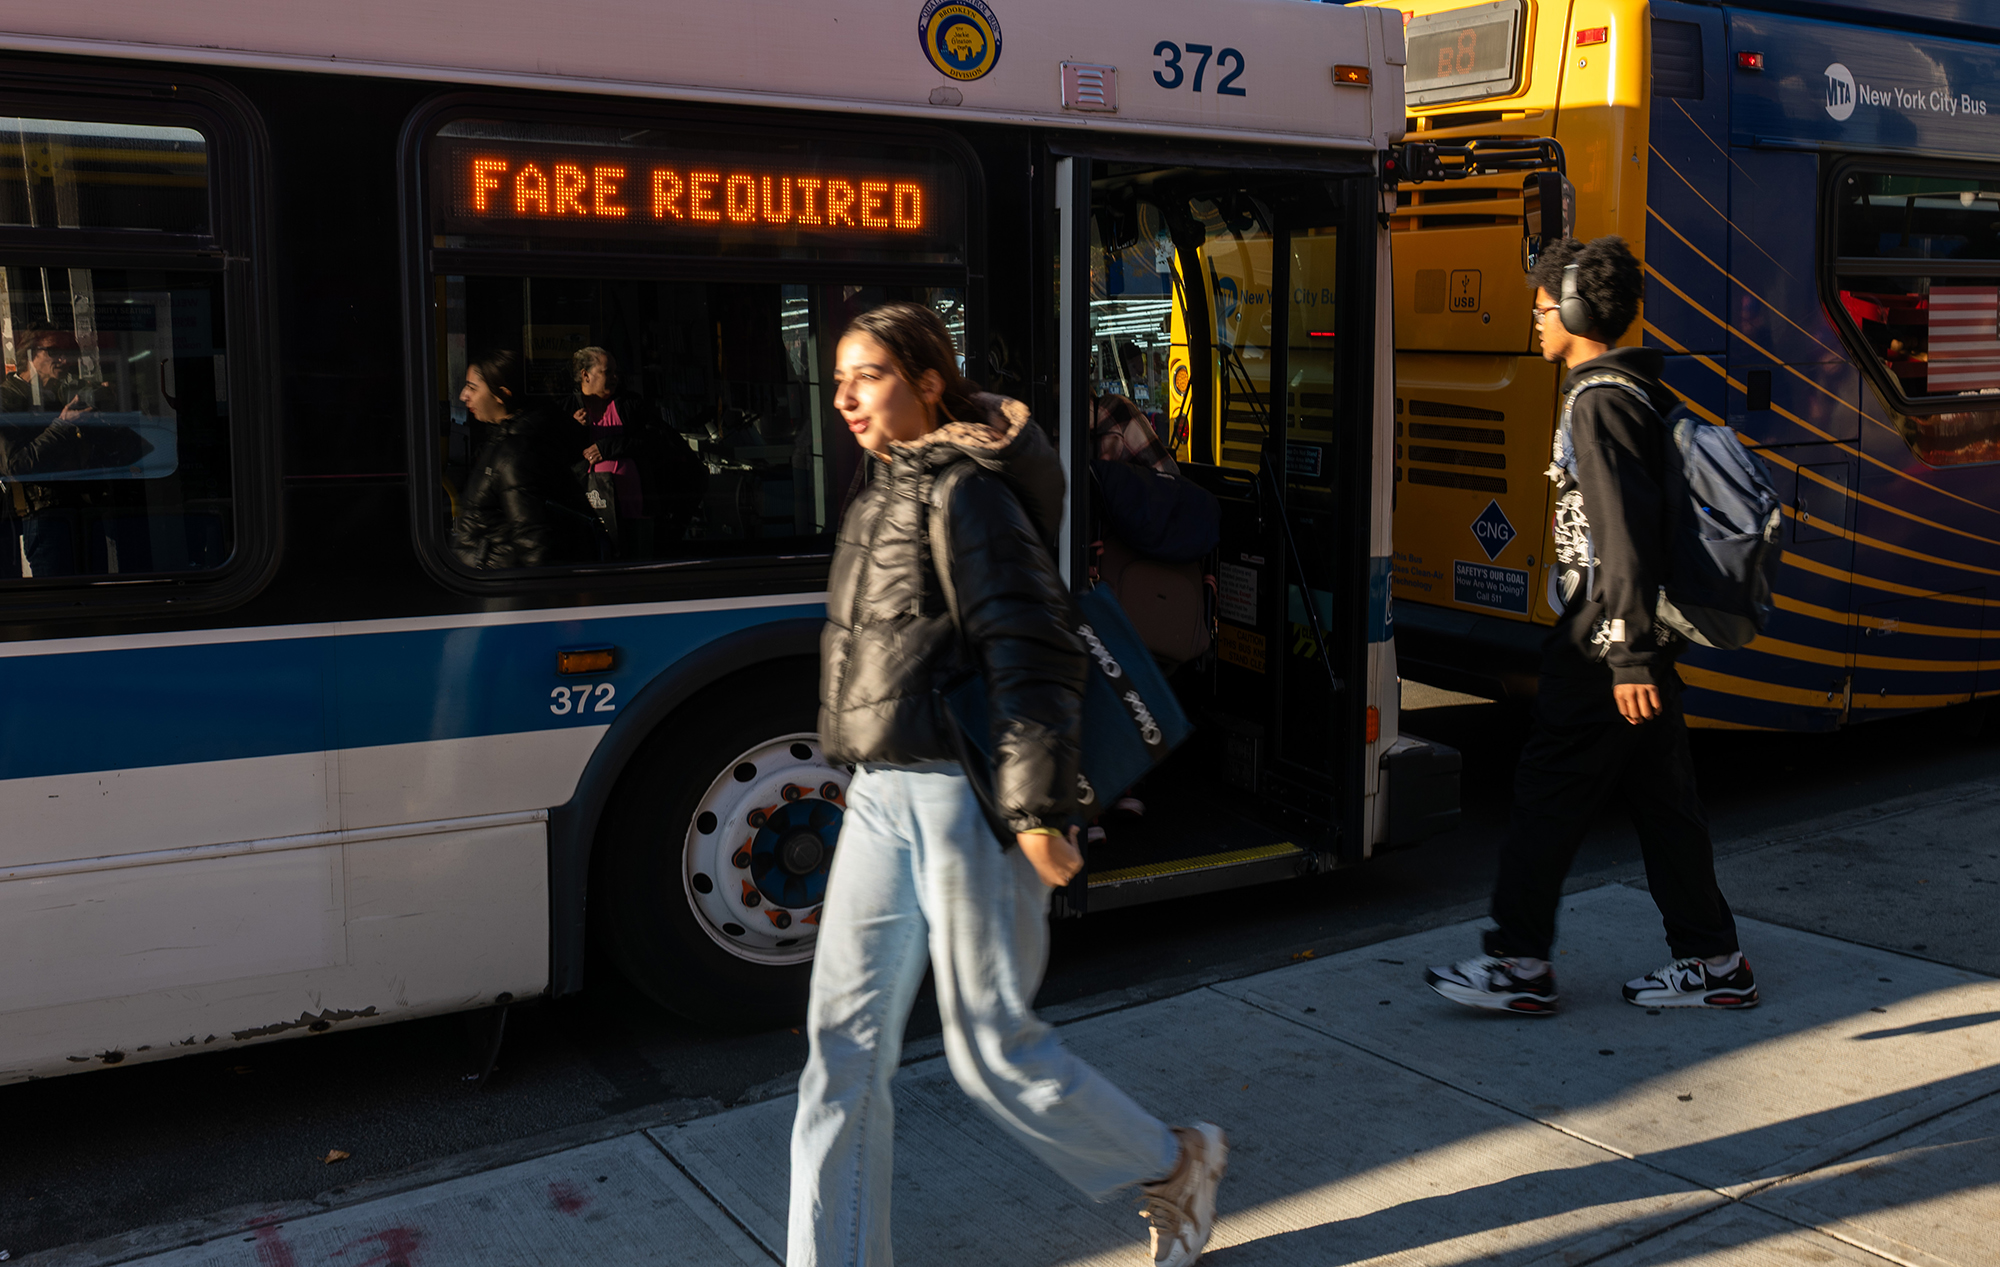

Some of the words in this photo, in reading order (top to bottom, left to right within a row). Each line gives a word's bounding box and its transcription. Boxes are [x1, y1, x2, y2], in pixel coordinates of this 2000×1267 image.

[938, 6, 977, 19] BROOKLYN
[987, 14, 999, 32] BUS
[951, 37, 973, 45] Gleason
[1437, 28, 1477, 78] B8
[949, 67, 983, 79] DIVISION
[1153, 40, 1246, 97] 372
[1825, 74, 1851, 108] MTA
[1859, 84, 1892, 106] New
[1894, 87, 1927, 110] York
[1929, 91, 1958, 117] City
[1961, 94, 1987, 116] Bus
[474, 160, 627, 216] FARE
[653, 170, 922, 229] REQUIRED
[1240, 289, 1264, 305] New
[1293, 288, 1318, 308] City
[1320, 289, 1337, 305] Bu
[1454, 297, 1475, 308] USB
[120, 306, 152, 315] SEATING
[1476, 520, 1509, 541] CNG
[1392, 551, 1407, 562] This
[1408, 553, 1423, 564] Bus
[1391, 563, 1409, 574] Uses
[1410, 566, 1444, 579] Clean-Air
[1456, 564, 1489, 579] SAFETY'S
[1489, 570, 1504, 582] OUR
[1505, 572, 1525, 585] GOAL
[1392, 575, 1433, 592] Technology
[1456, 576, 1472, 587] How
[1473, 579, 1485, 589] Are
[1485, 581, 1498, 591] We
[1499, 583, 1525, 598] Doing?
[1476, 590, 1490, 602] Call
[1491, 593, 1503, 604] 511
[1236, 630, 1264, 646] CAUTION
[1223, 637, 1237, 650] THIS
[1238, 642, 1251, 655] BUS
[1253, 647, 1265, 660] KNE
[1229, 650, 1249, 665] STAND
[550, 682, 616, 715] 372
